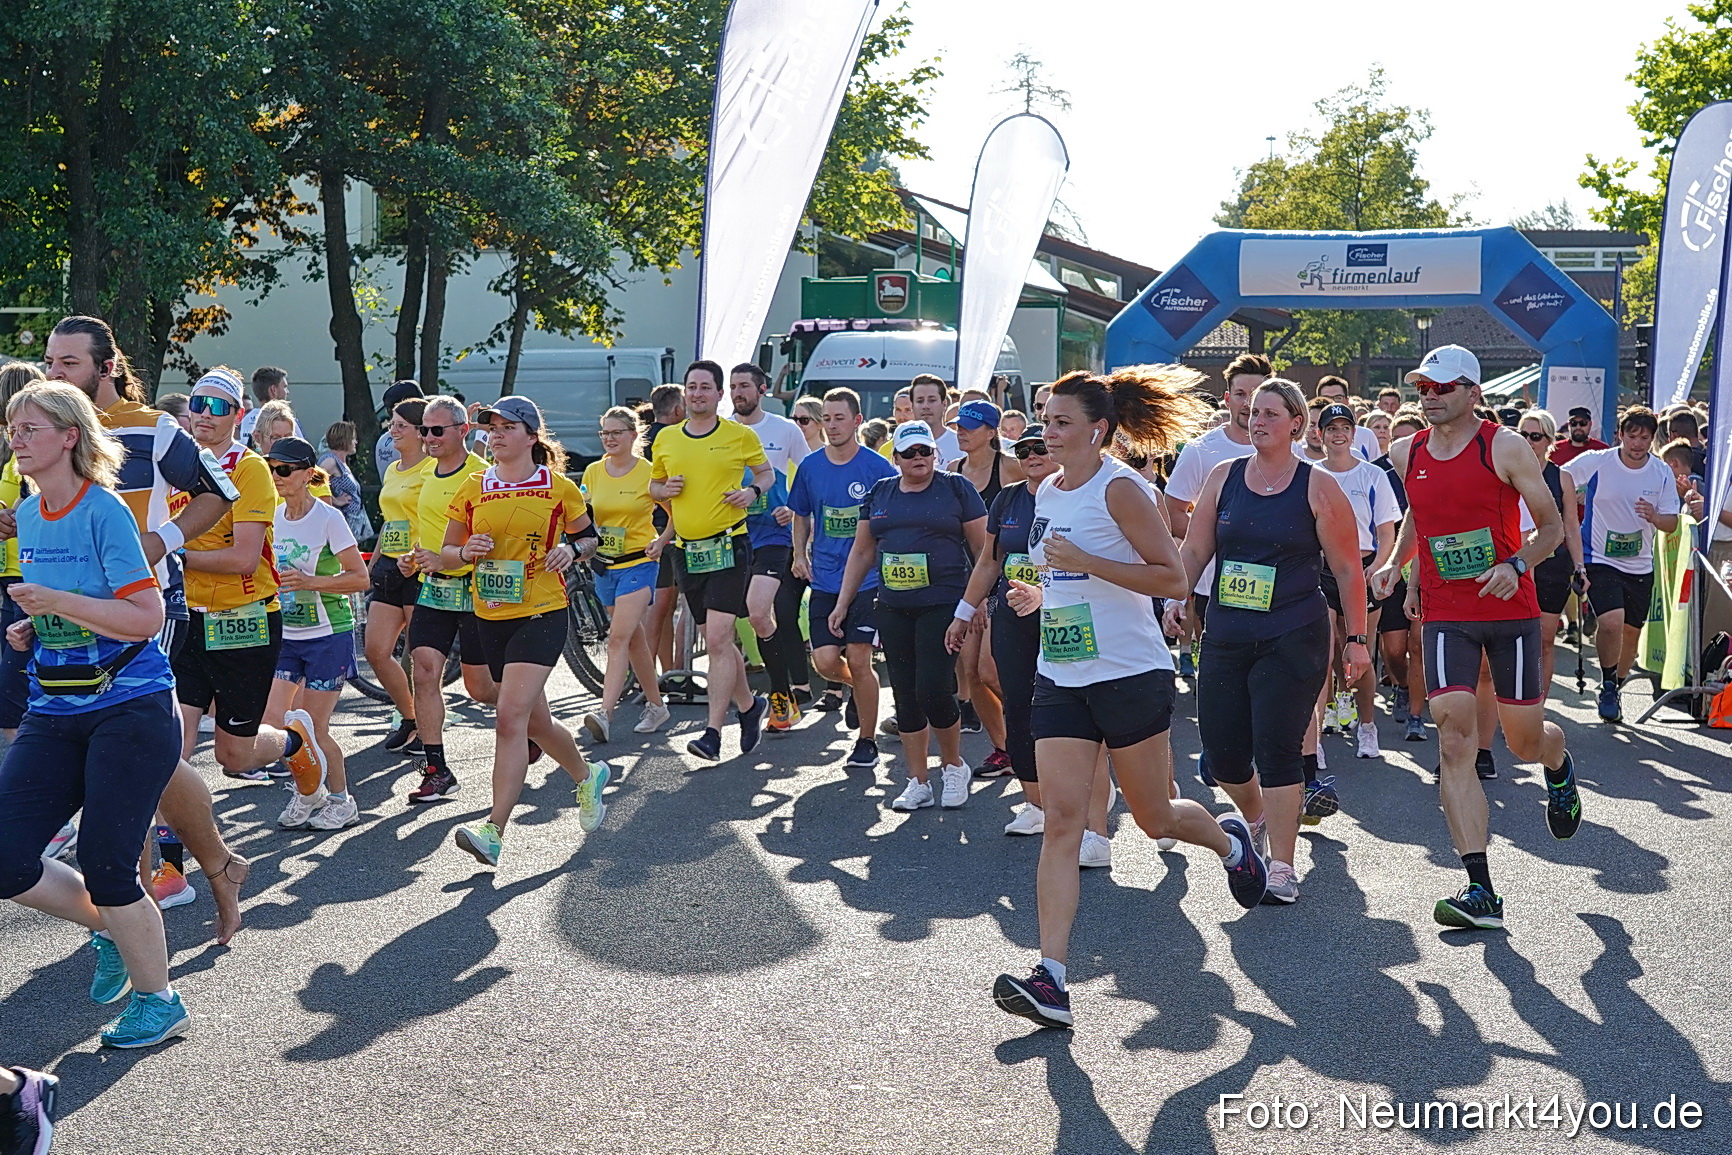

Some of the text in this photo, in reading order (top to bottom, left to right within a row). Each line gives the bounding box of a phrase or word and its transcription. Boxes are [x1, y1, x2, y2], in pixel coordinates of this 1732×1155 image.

[1354, 250, 1386, 260] Fischer
[1331, 266, 1422, 285] firmenlauf
[1160, 295, 1208, 307] Fischer
[1670, 287, 1718, 404] fischer-automobile.de
[816, 357, 856, 368] abavent
[480, 488, 553, 504] MAX BÖGL
[828, 516, 858, 529] 1759
[384, 531, 401, 543] 552
[1615, 541, 1635, 550] 320
[79, 555, 89, 563] eG
[692, 550, 711, 564] 561
[1442, 545, 1485, 566] 1313
[1485, 545, 1495, 567] 2022
[1436, 556, 1446, 572] RUN
[1447, 565, 1466, 573] Hagen
[1466, 561, 1485, 570] Bernd
[891, 566, 915, 579] 483
[1016, 566, 1042, 582] 492
[481, 573, 514, 589] 1609
[513, 577, 521, 598] 2022
[1228, 577, 1257, 595] 491
[431, 585, 452, 599] 555
[1261, 584, 1271, 605] 2022
[208, 624, 216, 642] RUN
[215, 617, 258, 635] 1585
[258, 618, 267, 640] 2022
[1043, 624, 1083, 646] 1223
[1082, 625, 1094, 653] 2022
